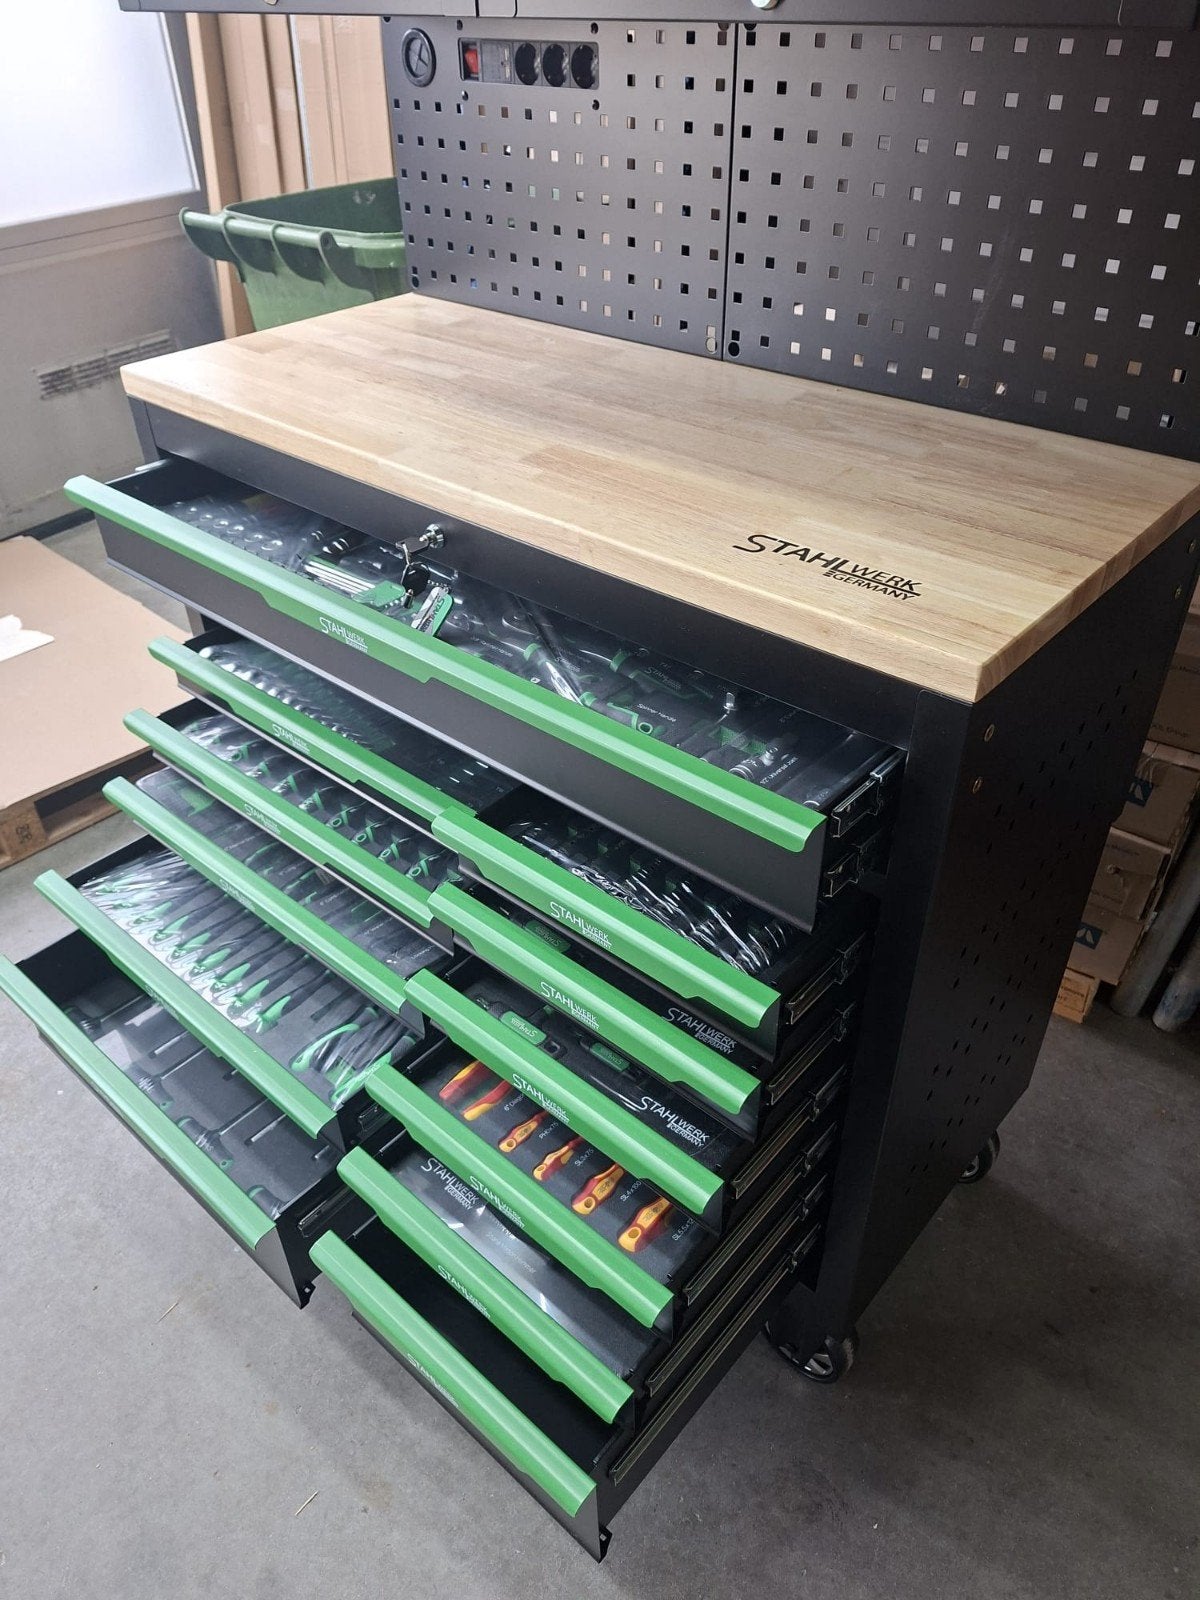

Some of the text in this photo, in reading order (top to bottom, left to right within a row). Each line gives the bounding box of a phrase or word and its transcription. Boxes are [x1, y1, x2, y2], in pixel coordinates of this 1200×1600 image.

[732, 534, 922, 595] STAHLWERK
[828, 571, 915, 600] GERMANY
[550, 901, 611, 943] STAHLWERK
[540, 981, 598, 1023] STAHLWERK
[661, 1007, 738, 1050] STAHLWERK
[632, 1096, 710, 1143] STAHLWERK
[668, 1123, 704, 1147] GERMANY
[420, 1157, 480, 1205] STAHLWERK
